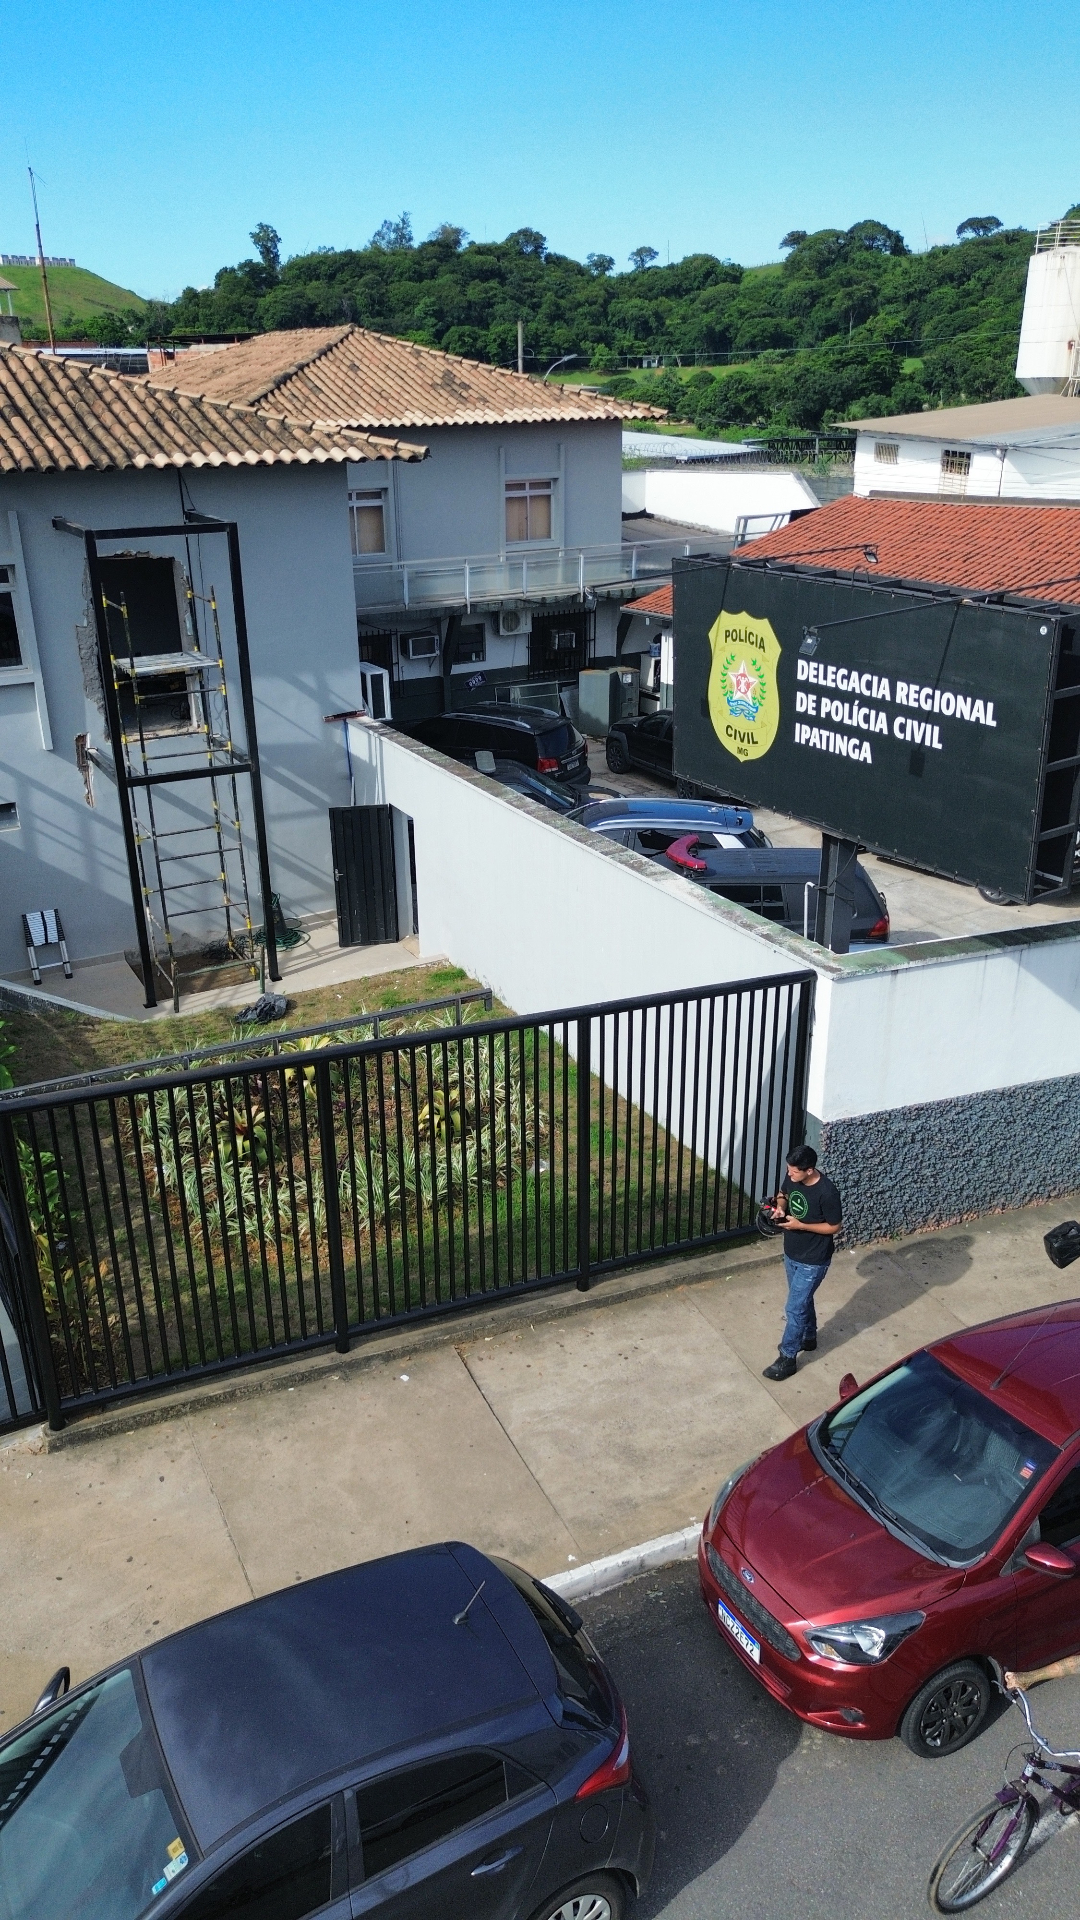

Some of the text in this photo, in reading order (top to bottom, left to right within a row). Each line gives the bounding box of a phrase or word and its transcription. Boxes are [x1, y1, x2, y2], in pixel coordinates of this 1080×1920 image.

[724, 626, 766, 653] POLÍCIA
[796, 659, 997, 727] DELEGACIA REGIONAL
[725, 724, 759, 745] CIVIL
[795, 691, 817, 716] DE
[820, 700, 889, 735] POLÍCIA
[893, 716, 943, 750] CIVIL
[736, 746, 749, 757] MG
[794, 722, 872, 764] IPATINGA
